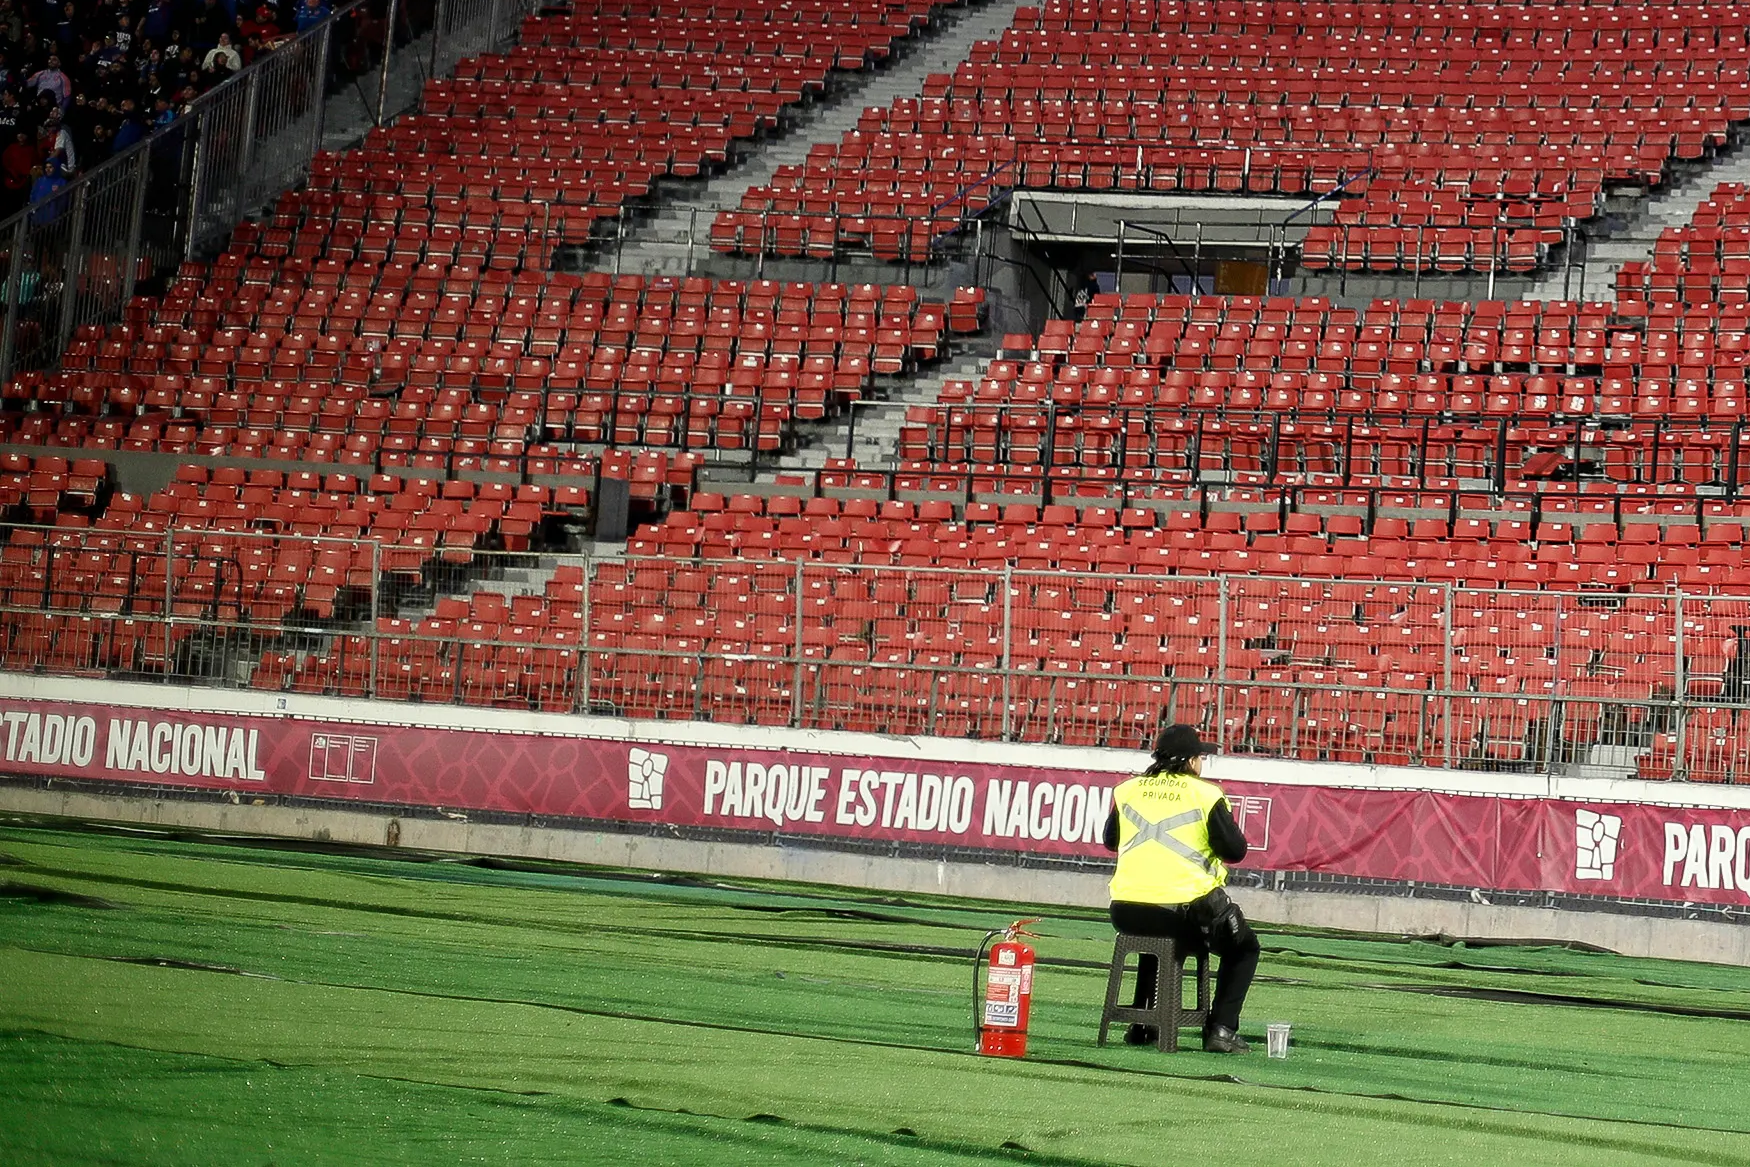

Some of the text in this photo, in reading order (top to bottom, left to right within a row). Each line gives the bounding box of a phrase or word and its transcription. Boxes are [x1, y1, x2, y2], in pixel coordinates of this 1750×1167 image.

[0, 712, 266, 781] TADIO NACIONAL
[703, 760, 1113, 845] PARQUE ESTADIO NACION
[1138, 778, 1188, 789] SEGURIDAD
[1142, 791, 1181, 801] PRIVADA
